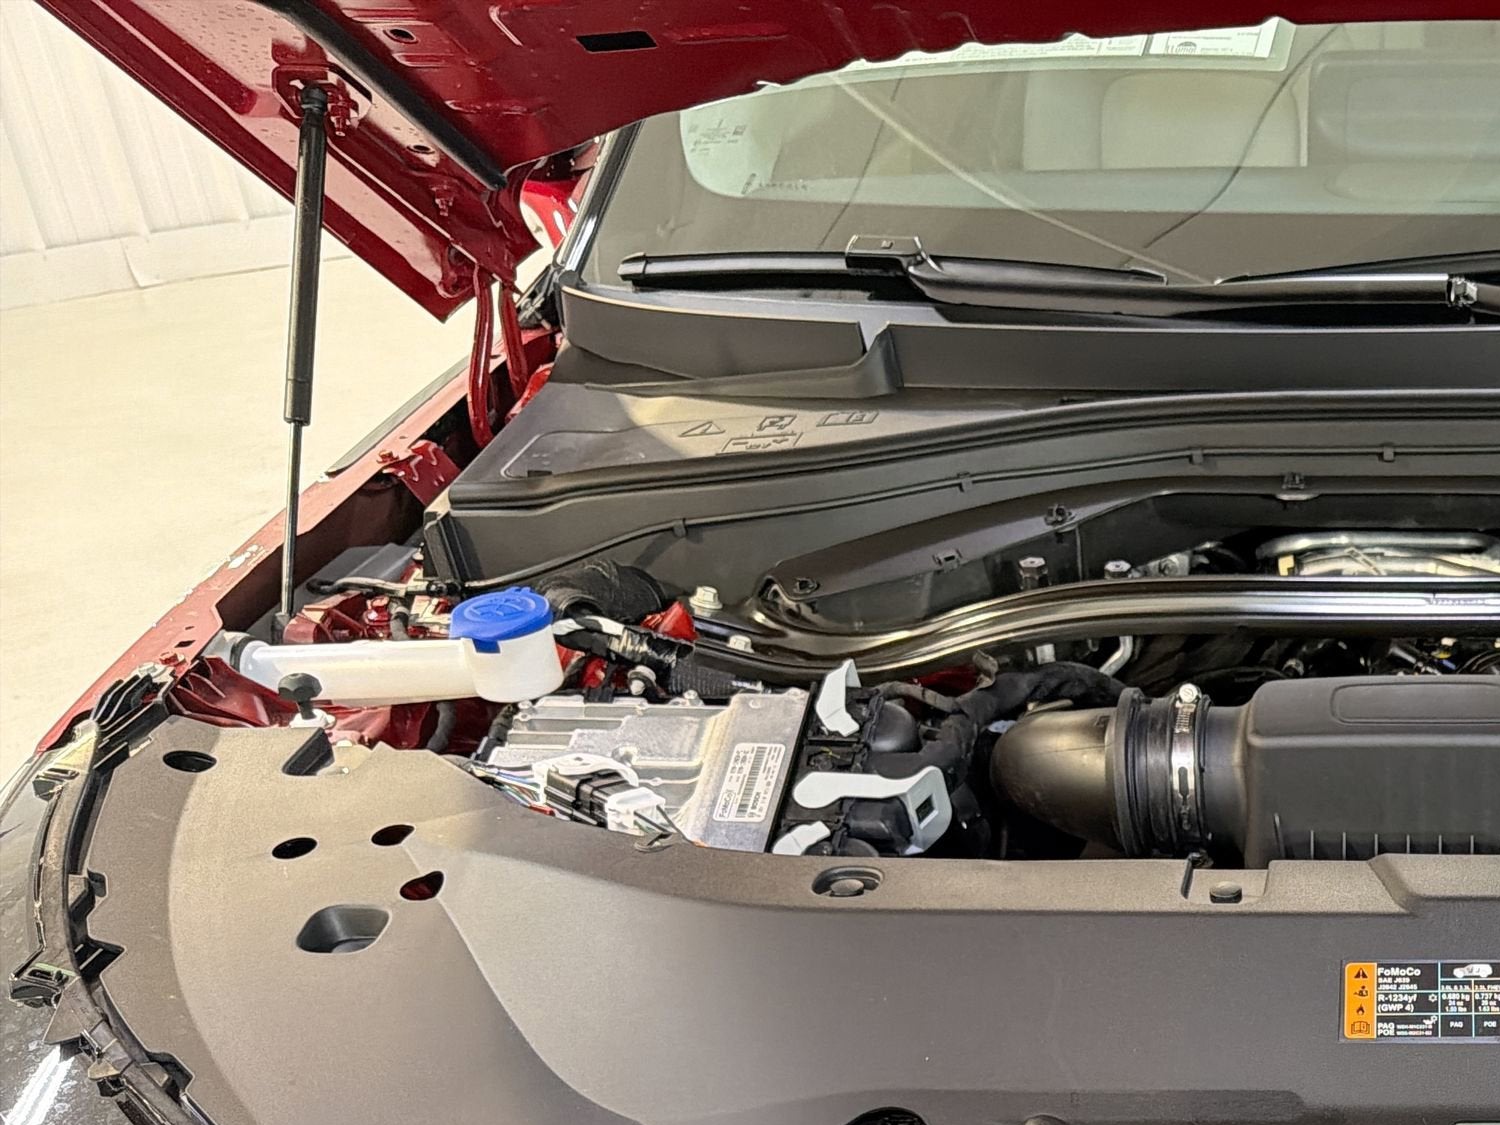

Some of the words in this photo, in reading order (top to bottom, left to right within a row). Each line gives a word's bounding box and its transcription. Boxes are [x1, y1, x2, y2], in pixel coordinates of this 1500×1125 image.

[1377, 967, 1422, 976] FoMoCo
[1378, 994, 1418, 1003] R-1234yf
[1461, 993, 1470, 1001] kg
[1378, 1003, 1403, 1012] (GWP
[1404, 1003, 1414, 1012] 4)
